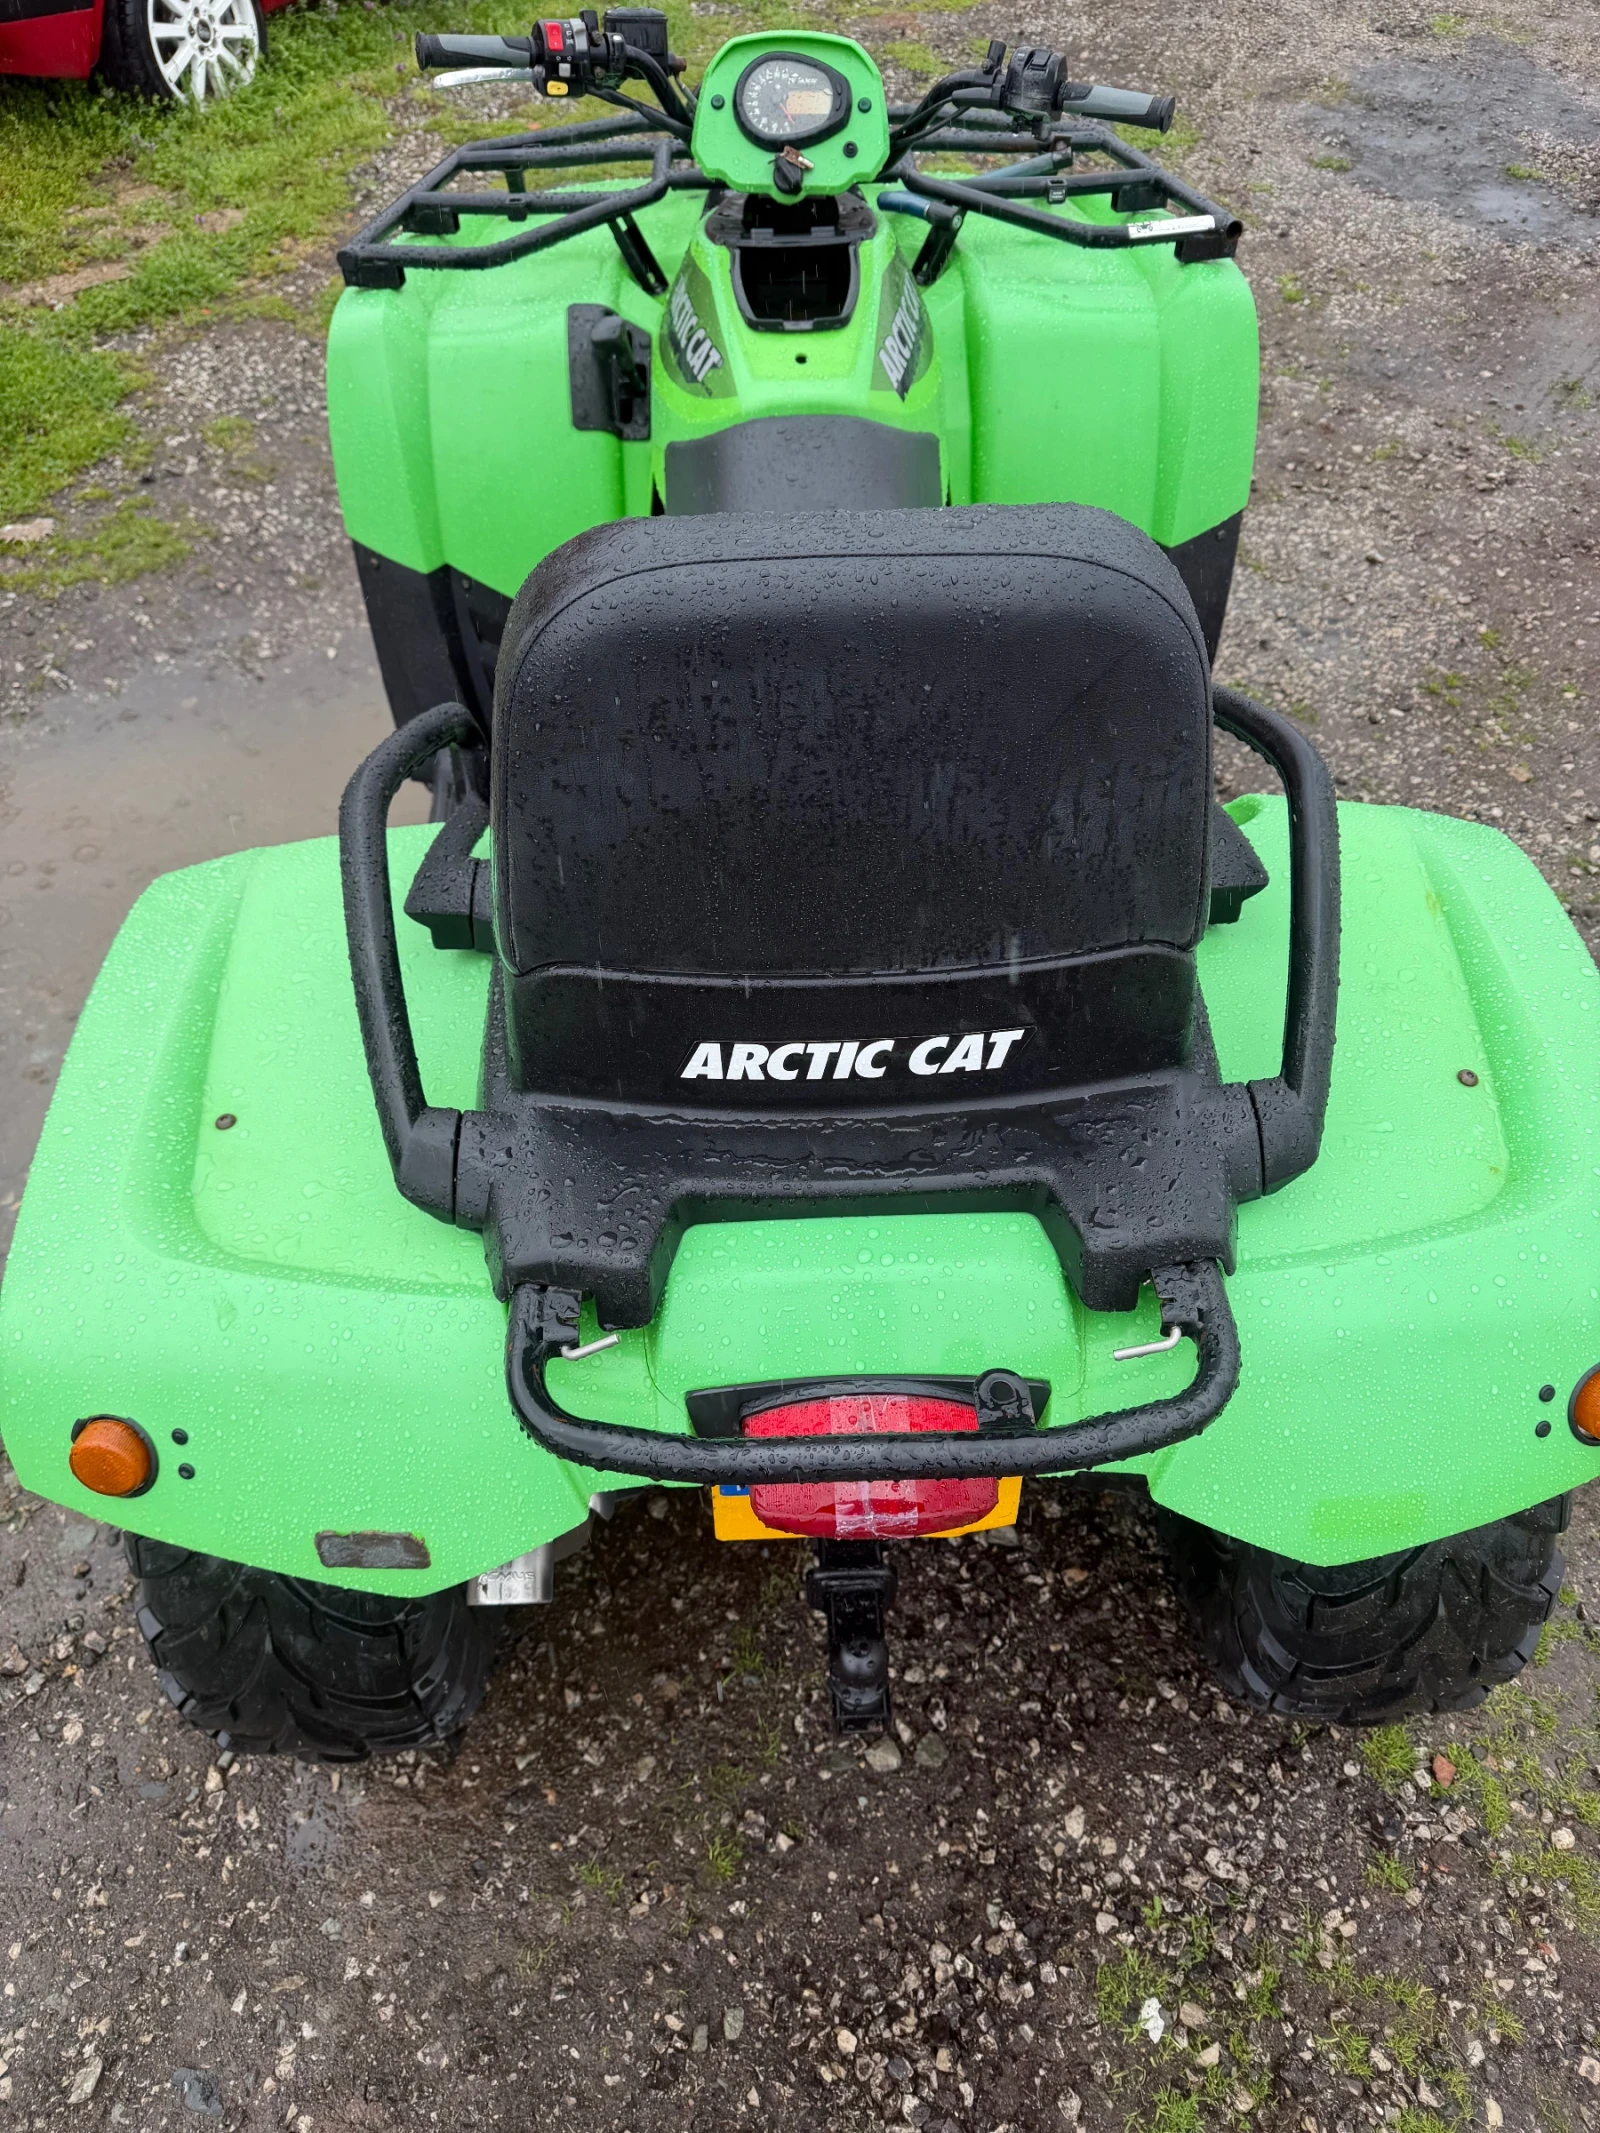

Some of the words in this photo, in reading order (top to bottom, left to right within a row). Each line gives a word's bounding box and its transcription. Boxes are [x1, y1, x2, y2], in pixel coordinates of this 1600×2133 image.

[686, 328, 722, 382] CAT
[880, 296, 918, 390] ARCTIC
[680, 1039, 895, 1081] ARCTIC
[908, 1029, 1025, 1077] CAT
